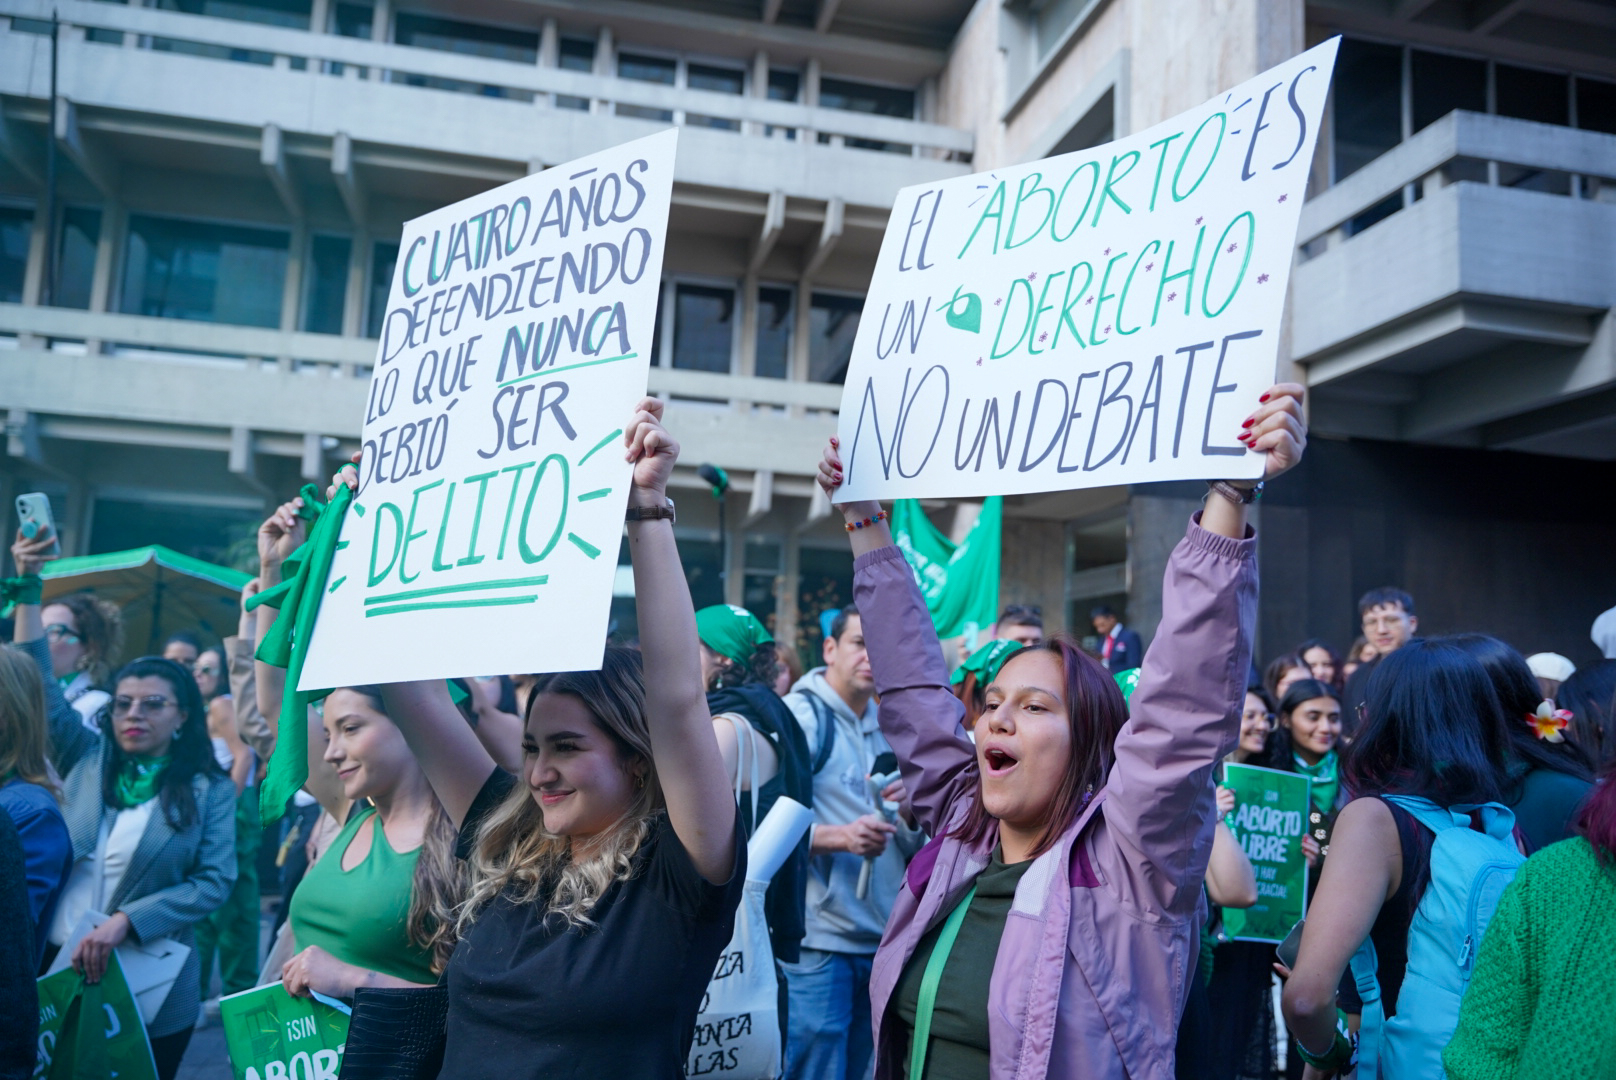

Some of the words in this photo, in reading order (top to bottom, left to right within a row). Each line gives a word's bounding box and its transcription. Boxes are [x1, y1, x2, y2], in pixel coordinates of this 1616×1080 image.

[403, 196, 532, 298] CUATRO
[531, 159, 648, 246] AÑOS
[899, 188, 943, 272] EL
[957, 111, 1227, 260] ABORTO
[1241, 65, 1318, 181] ES
[380, 227, 652, 366] DEFENDIENDO
[876, 296, 931, 359] UN
[989, 210, 1255, 360] DERECHO
[366, 368, 400, 426] LO
[412, 334, 482, 405] QUE
[496, 301, 631, 382] NUNCA
[848, 364, 950, 485] NO
[954, 390, 1021, 473] UN
[1018, 329, 1263, 473] DEBATE
[353, 398, 459, 500] DEBIÓ
[477, 381, 578, 459] SER
[366, 453, 570, 588] DELITO
[1235, 803, 1301, 836] ABORTO
[693, 1012, 752, 1047] ANTA
[714, 951, 744, 980] ZA
